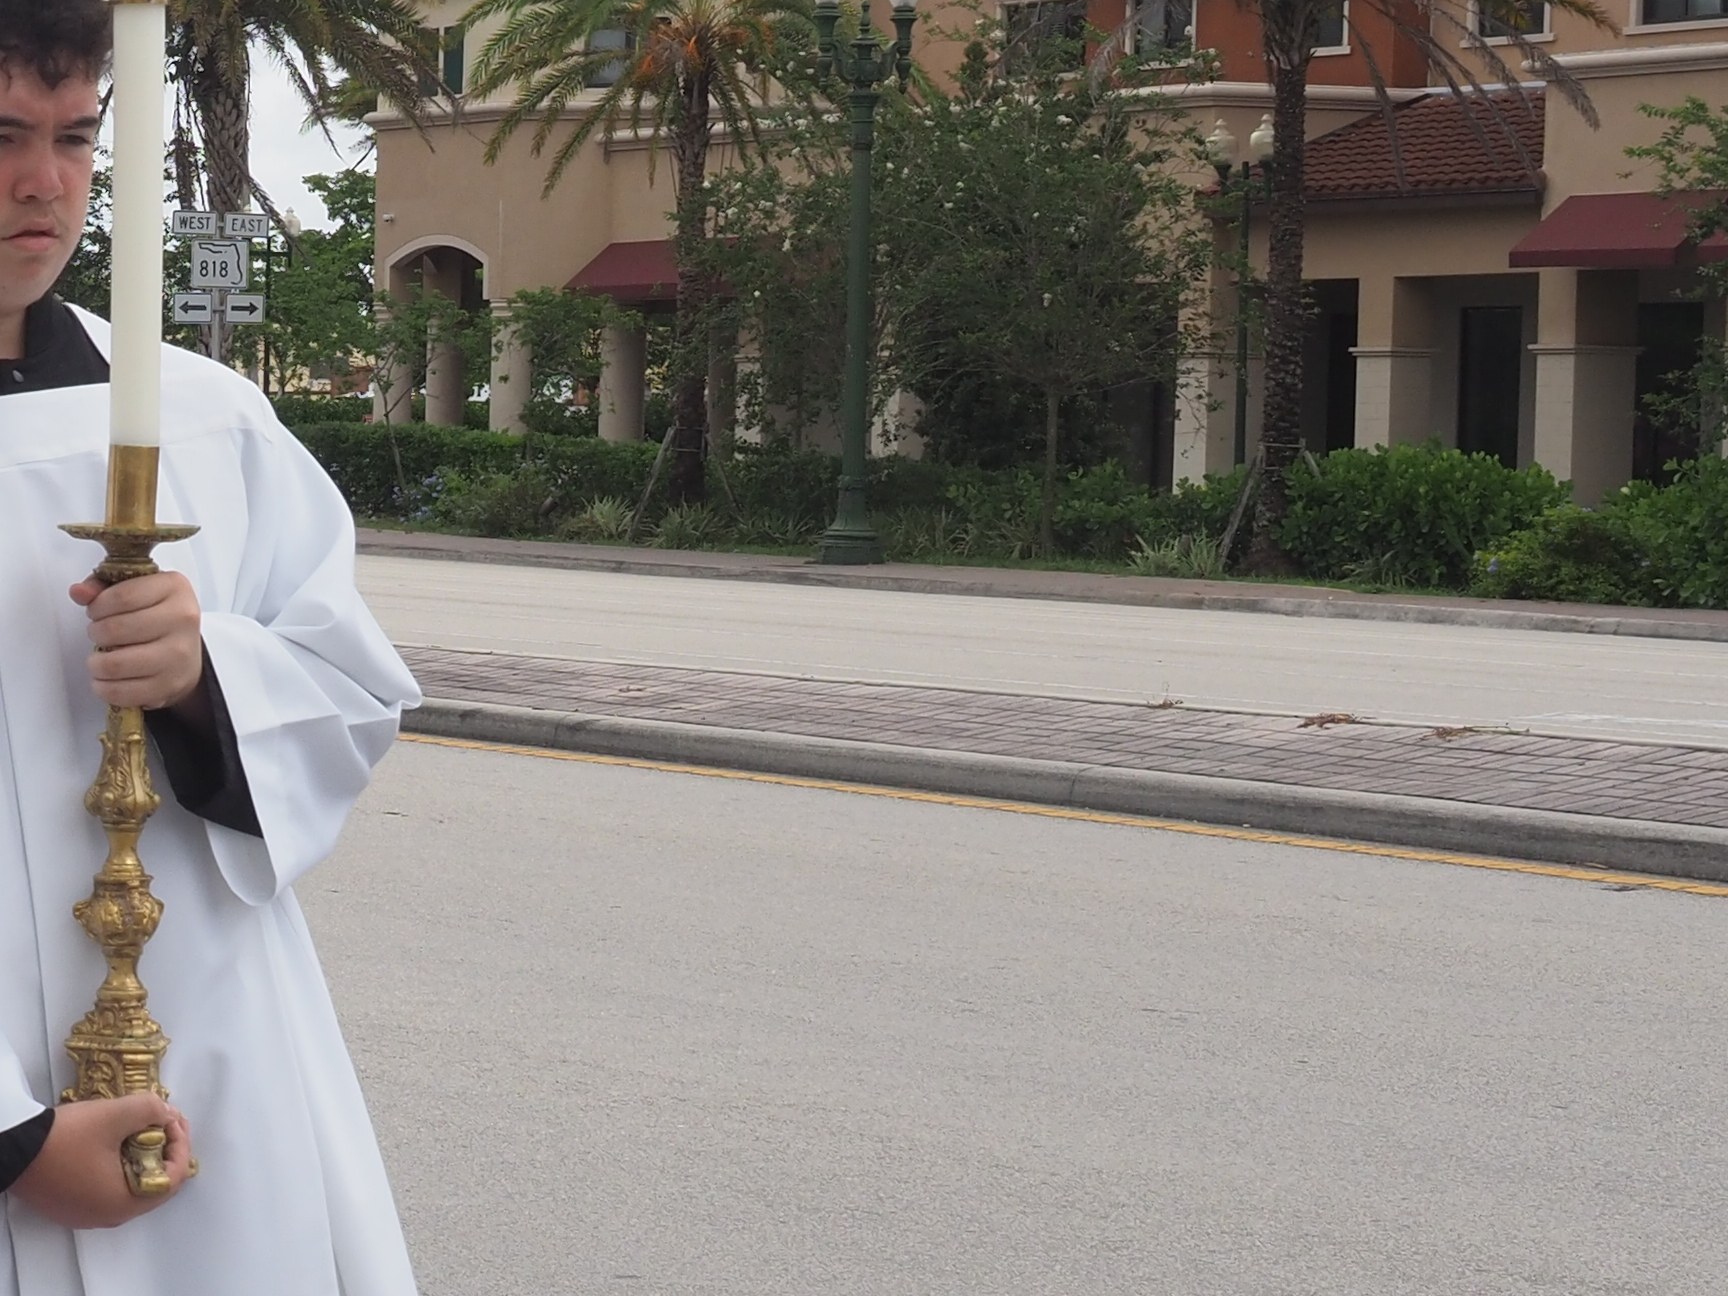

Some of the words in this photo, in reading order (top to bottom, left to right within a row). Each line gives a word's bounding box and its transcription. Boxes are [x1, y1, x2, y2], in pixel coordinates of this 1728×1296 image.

[179, 216, 211, 230] WEST
[231, 218, 263, 233] EAST
[200, 260, 228, 278] 818
